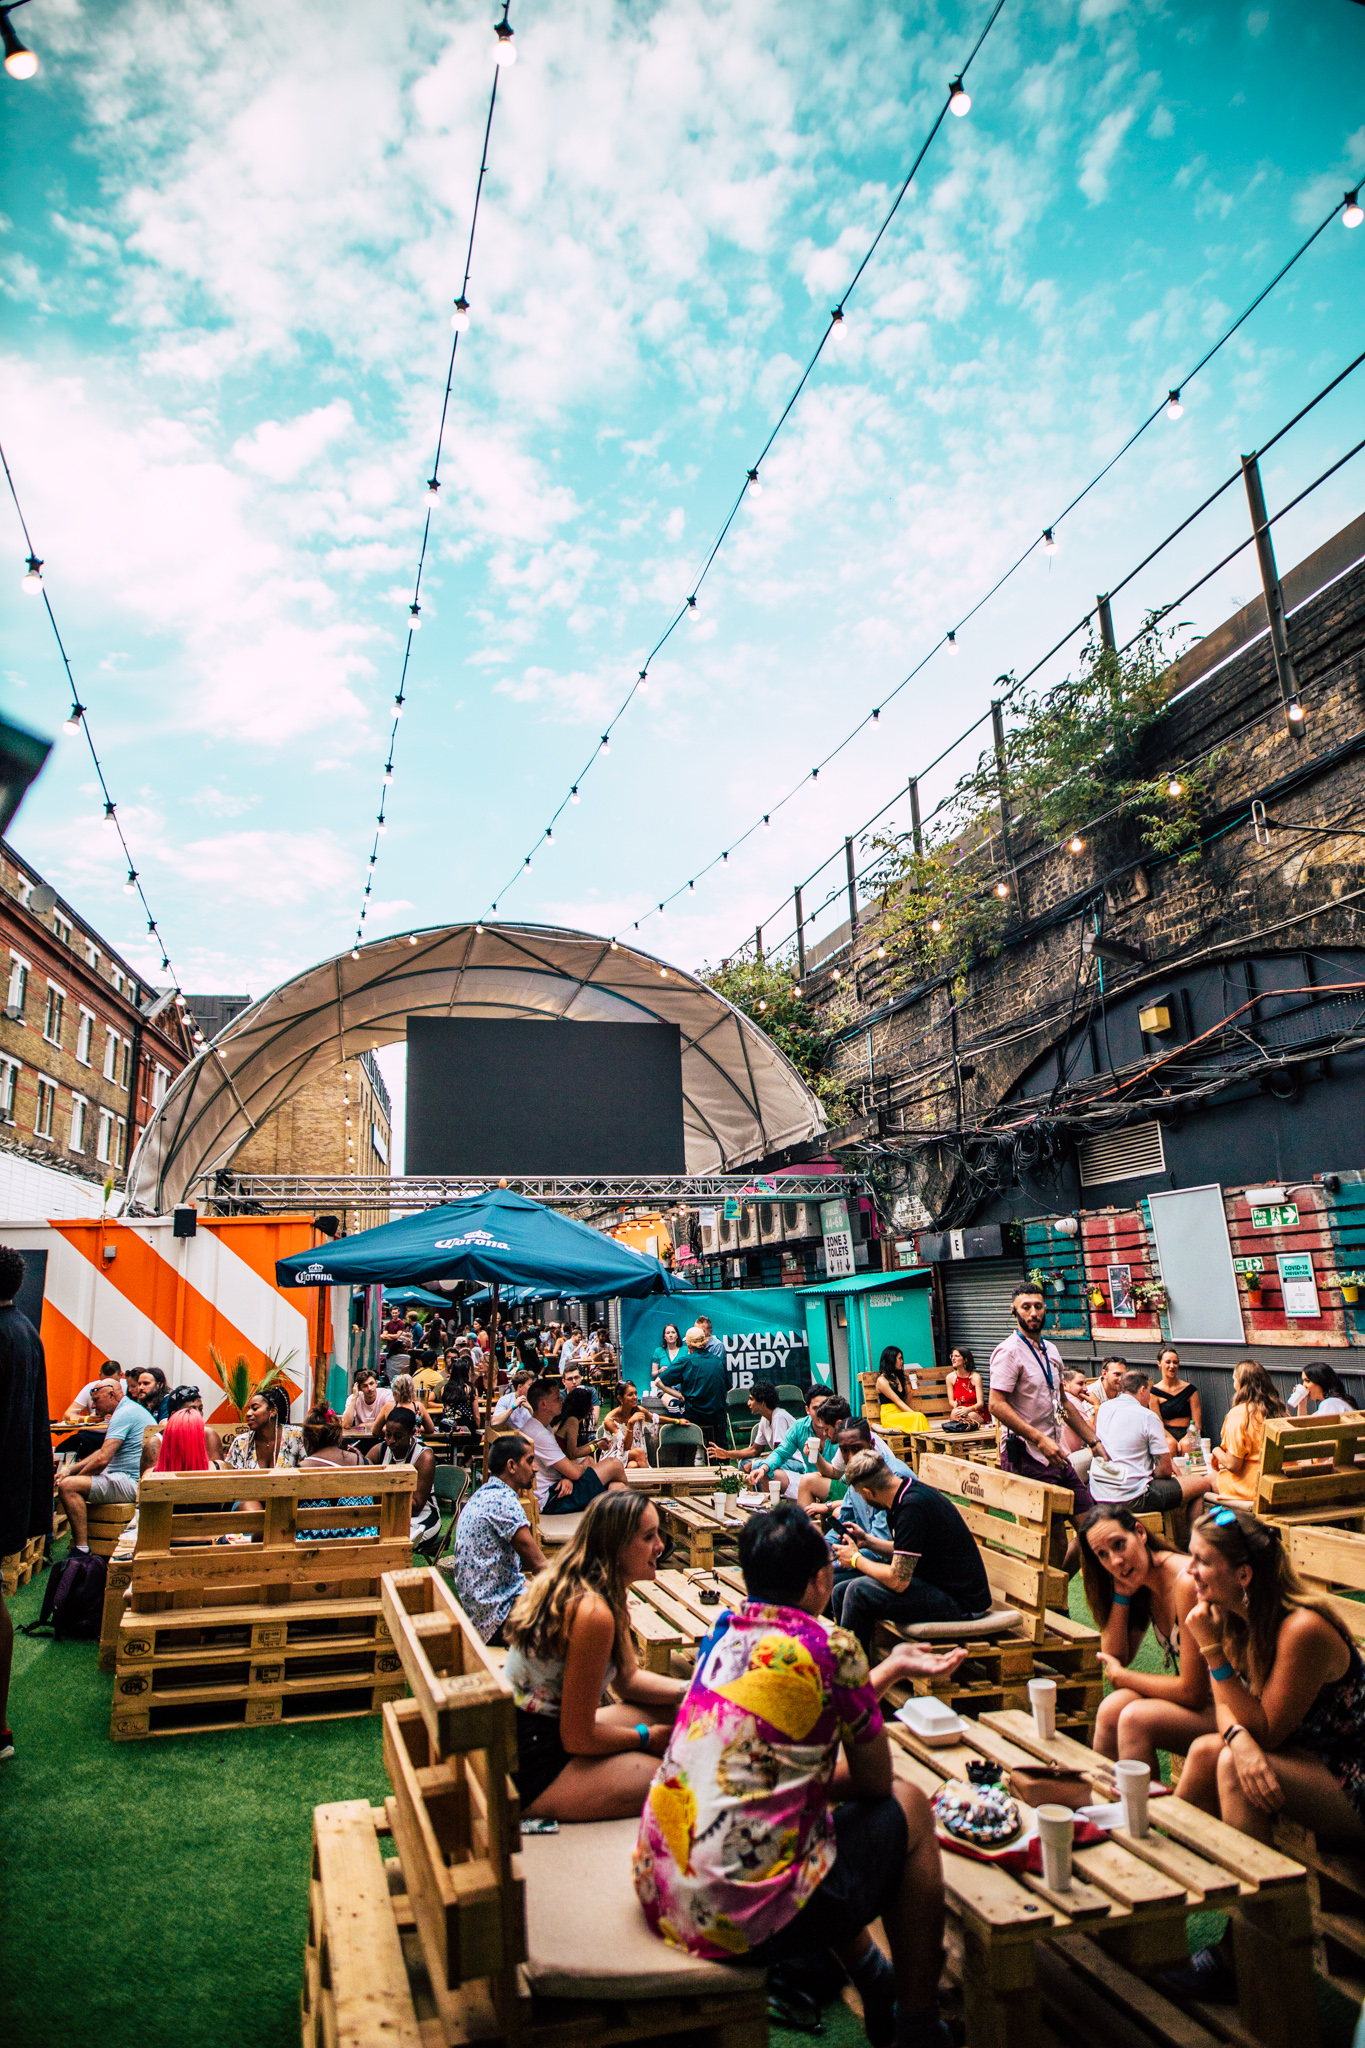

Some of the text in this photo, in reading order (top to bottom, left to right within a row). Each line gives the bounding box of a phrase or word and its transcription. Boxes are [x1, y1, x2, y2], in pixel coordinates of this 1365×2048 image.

[1254, 1210, 1267, 1219] Fire
[1255, 1217, 1268, 1226] exit
[434, 1238, 511, 1250] Corona
[826, 1234, 848, 1248] ZONE 3
[954, 1240, 960, 1251] E
[827, 1246, 849, 1258] TOILETS
[294, 1271, 334, 1285] Corona
[712, 1329, 809, 1352] UXHALL
[726, 1349, 791, 1372] MEDY
[960, 1480, 985, 1499] Corona
